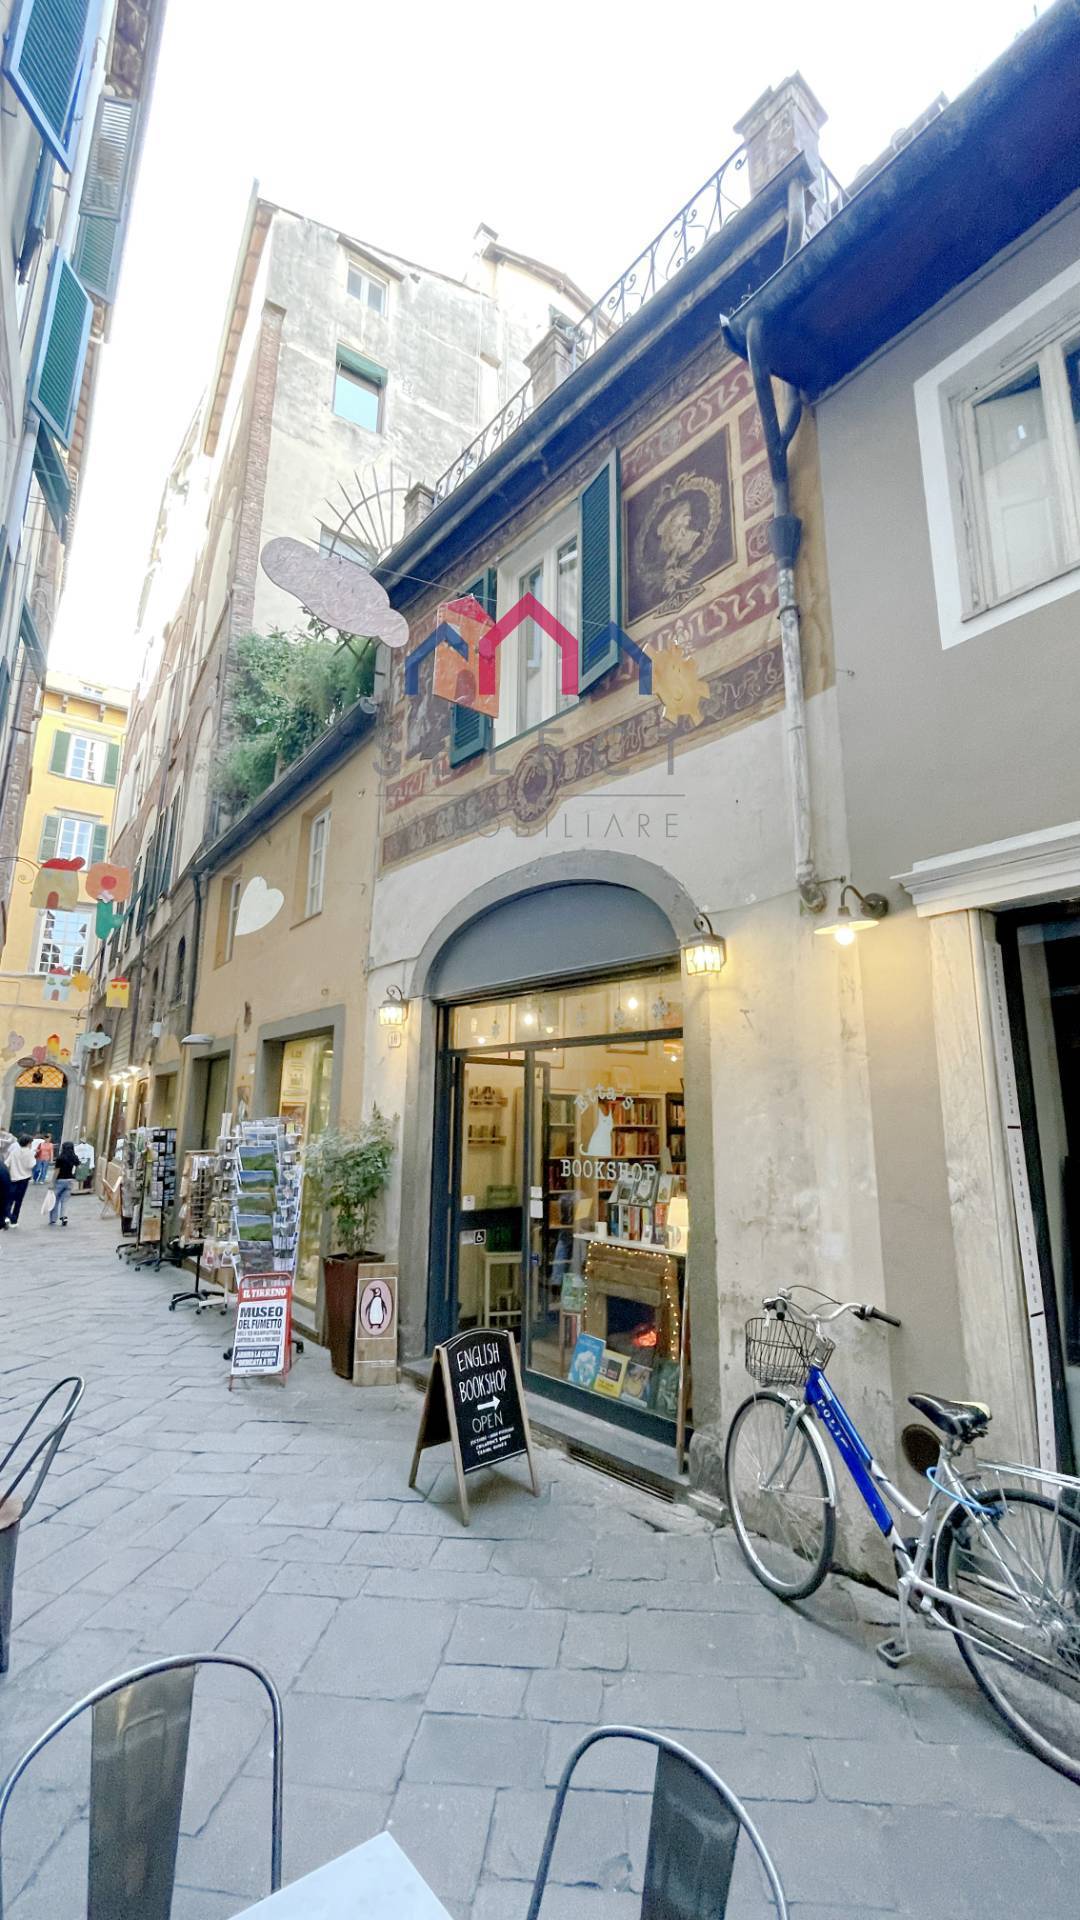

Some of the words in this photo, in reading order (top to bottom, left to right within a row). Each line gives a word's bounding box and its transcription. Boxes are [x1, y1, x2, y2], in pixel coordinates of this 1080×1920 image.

[560, 1159, 657, 1181] BOOKSHOP
[242, 1289, 251, 1299] IL
[251, 1287, 287, 1298] TIRRENO
[239, 1306, 284, 1318] MUSEO
[237, 1319, 250, 1330] DEL
[251, 1318, 283, 1329] FUMETTO
[456, 1342, 500, 1372] ENGLISH
[458, 1368, 507, 1403] BOOKSHOP
[471, 1411, 503, 1434] OPEN
